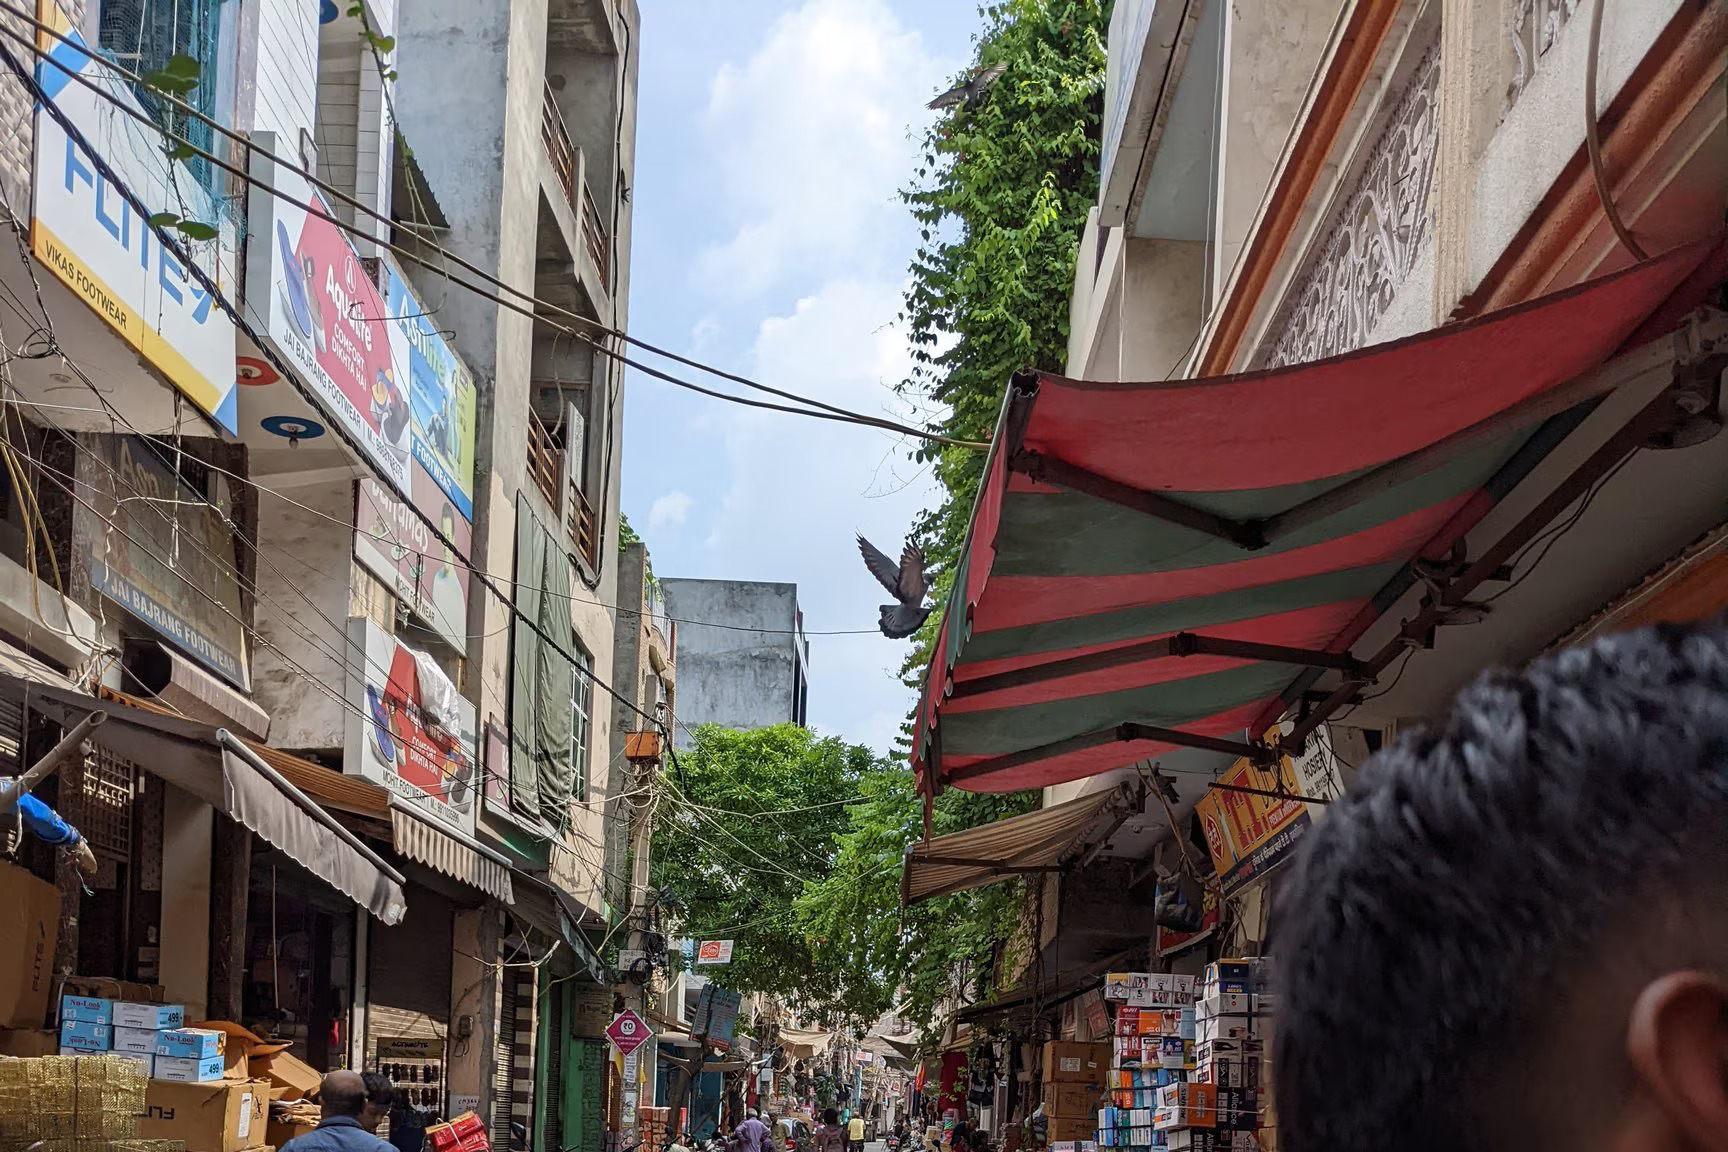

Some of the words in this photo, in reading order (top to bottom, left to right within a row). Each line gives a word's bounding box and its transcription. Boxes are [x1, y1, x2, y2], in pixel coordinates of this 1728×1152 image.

[45, 240, 75, 281] VIKAS
[76, 269, 128, 330] FOOTWEAR
[331, 338, 356, 377] DIKHTA
[355, 368, 368, 392] HAI
[334, 323, 365, 372] COMFORT
[283, 329, 295, 354] JAI
[295, 342, 327, 388] BAJRANG
[327, 378, 361, 428] FOOTWEAR
[416, 440, 452, 494] FOOTWEAR
[111, 577, 131, 604] JAI
[132, 591, 183, 637] BAJRANG
[184, 628, 237, 675] FOOTWEAR
[1231, 1091, 1239, 1125] Alliance
